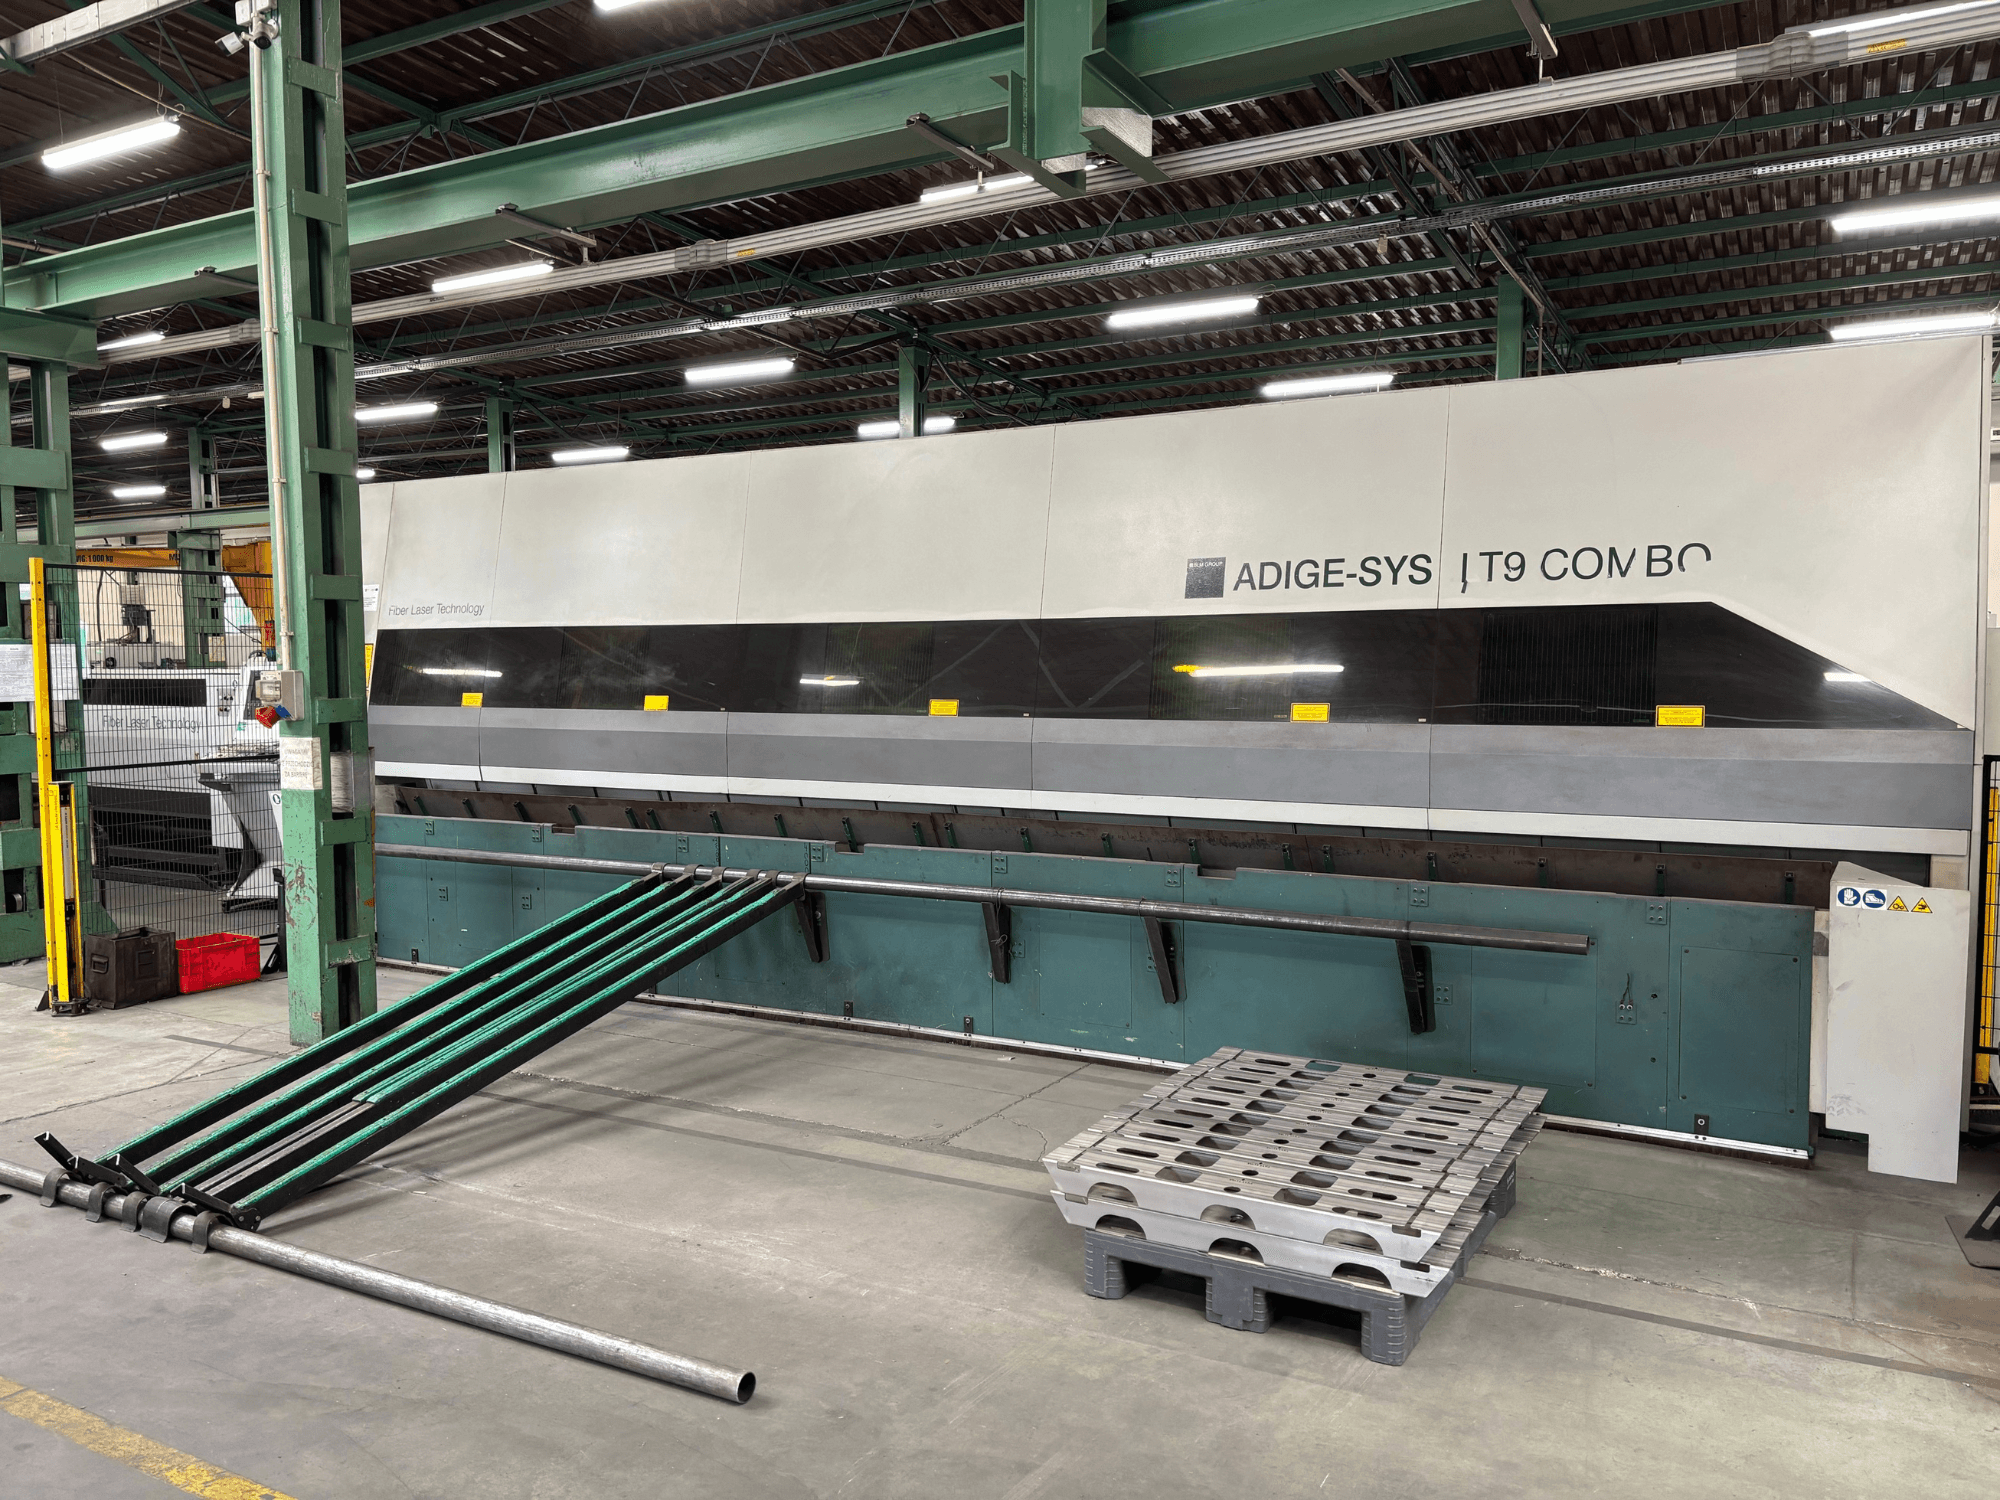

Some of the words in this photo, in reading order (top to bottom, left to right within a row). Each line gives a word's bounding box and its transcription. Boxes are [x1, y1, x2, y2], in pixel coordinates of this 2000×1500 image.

[1233, 554, 1432, 591] ADIGE-SYS
[388, 605, 409, 616] Fiber
[411, 604, 435, 615] Laser
[437, 603, 485, 616] Technology
[103, 715, 124, 728] Fiber
[126, 716, 150, 728] Laser
[151, 716, 202, 733] Technology
